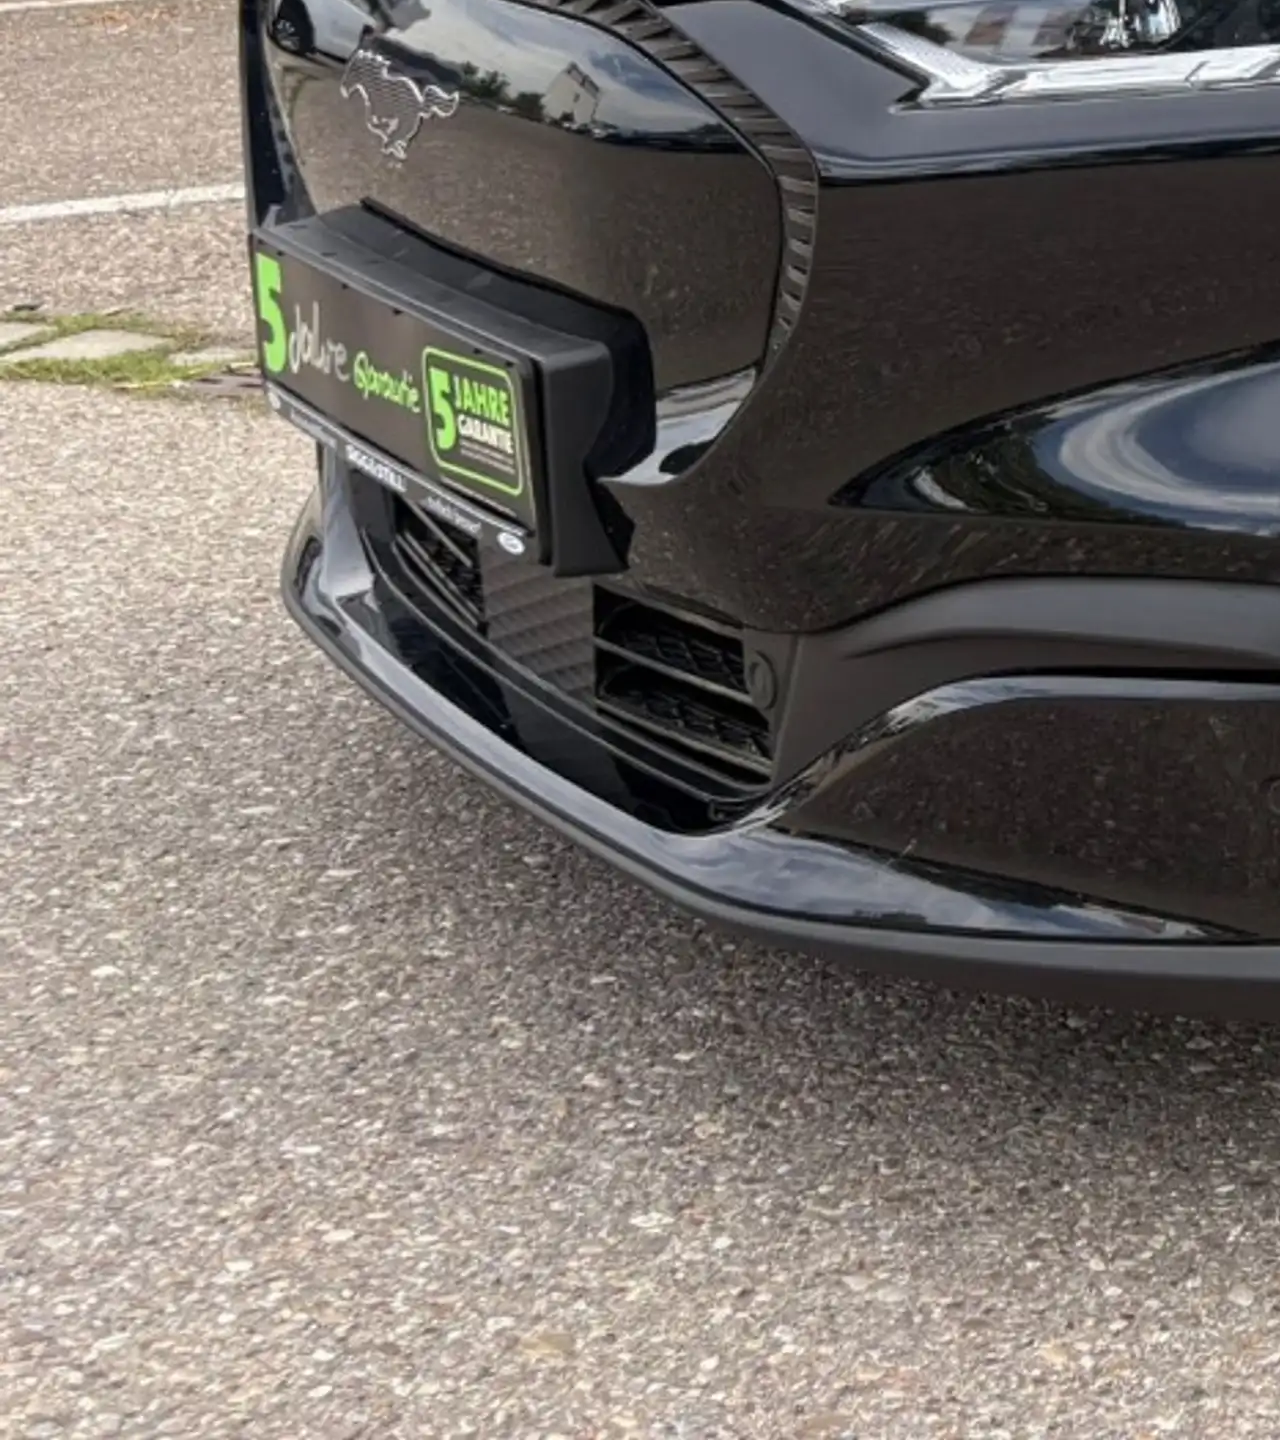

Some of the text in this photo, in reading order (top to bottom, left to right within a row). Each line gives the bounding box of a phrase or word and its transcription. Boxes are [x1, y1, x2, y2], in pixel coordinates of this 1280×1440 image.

[256, 251, 287, 373] 5
[429, 366, 511, 450] 5 JAHRE
